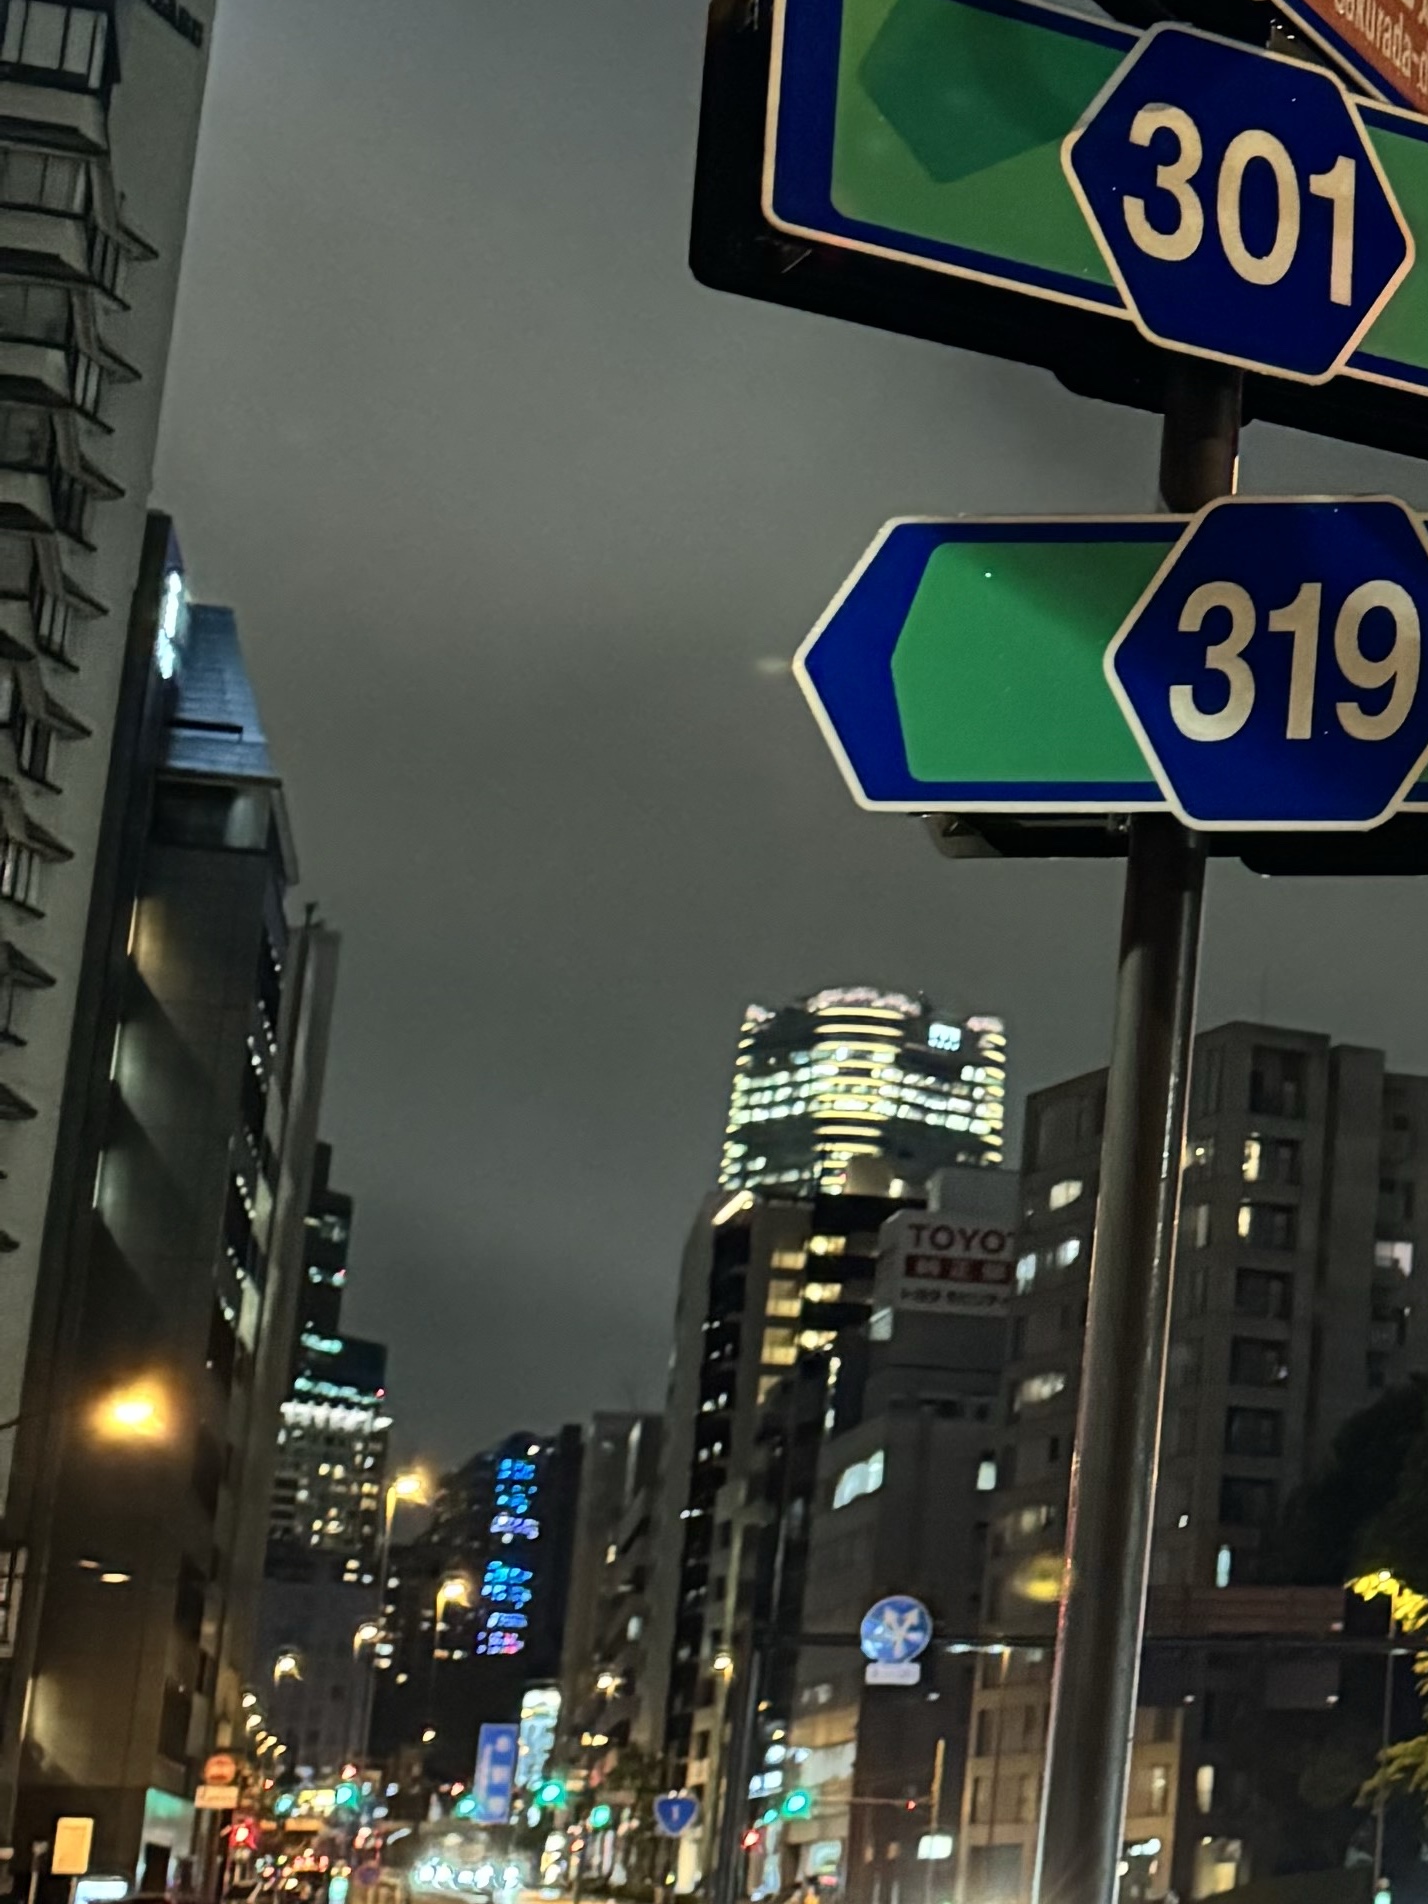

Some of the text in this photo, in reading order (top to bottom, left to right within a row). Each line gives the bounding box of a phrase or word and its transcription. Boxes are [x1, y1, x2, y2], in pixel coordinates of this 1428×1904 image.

[1123, 102, 1356, 306] 301
[1169, 580, 1421, 742] 319
[908, 1223, 1014, 1254] TOYO
